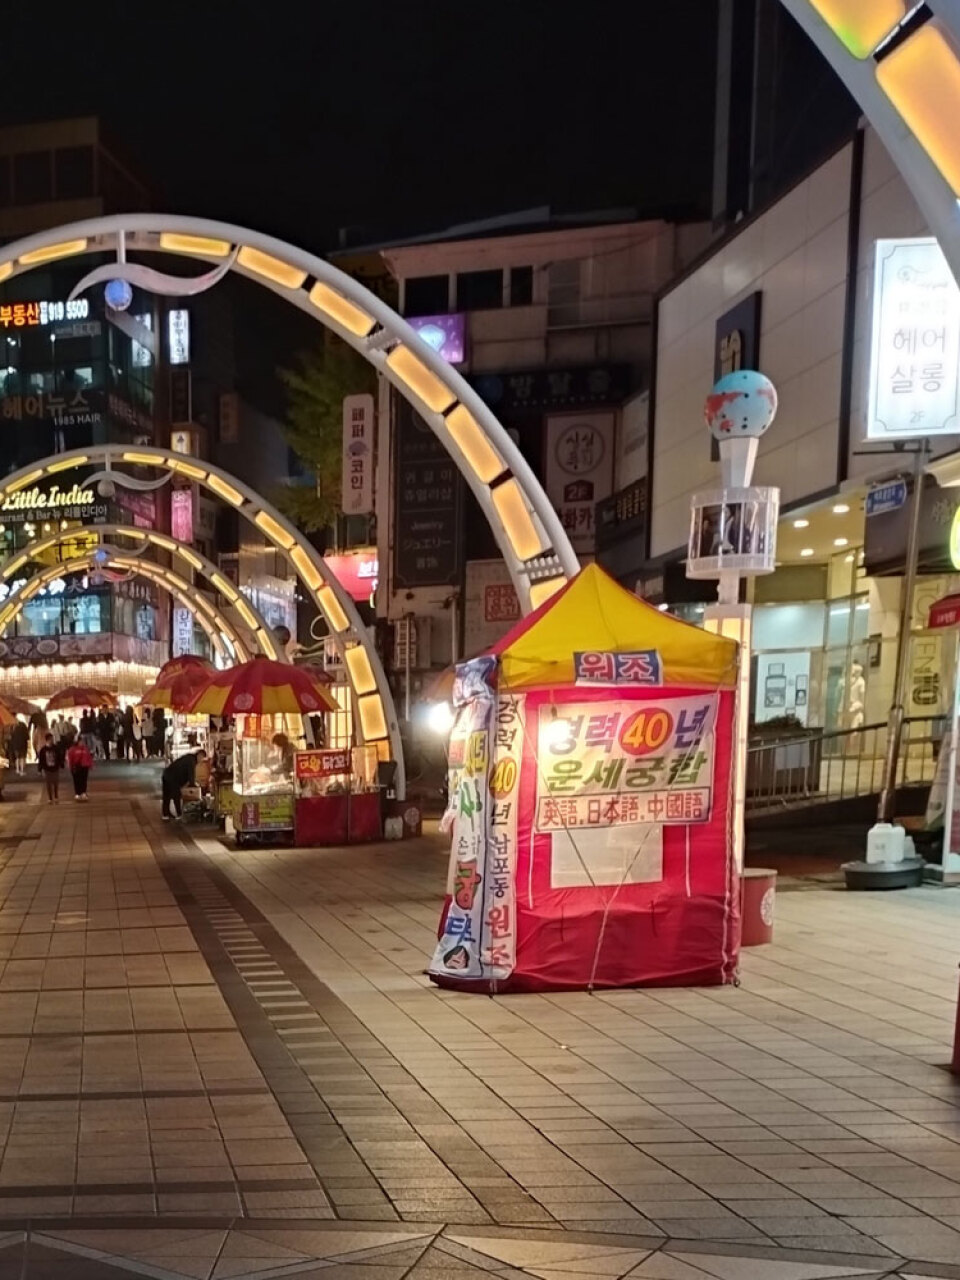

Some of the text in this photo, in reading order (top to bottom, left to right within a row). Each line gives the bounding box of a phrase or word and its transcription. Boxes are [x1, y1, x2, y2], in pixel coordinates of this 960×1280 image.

[892, 327, 946, 354] 헤어
[77, 413, 101, 424] HAIR
[1, 484, 95, 511] Little India
[579, 652, 657, 683] 원조
[621, 712, 669, 749] 40
[674, 705, 710, 749] 년
[546, 751, 708, 792] 운세궁합
